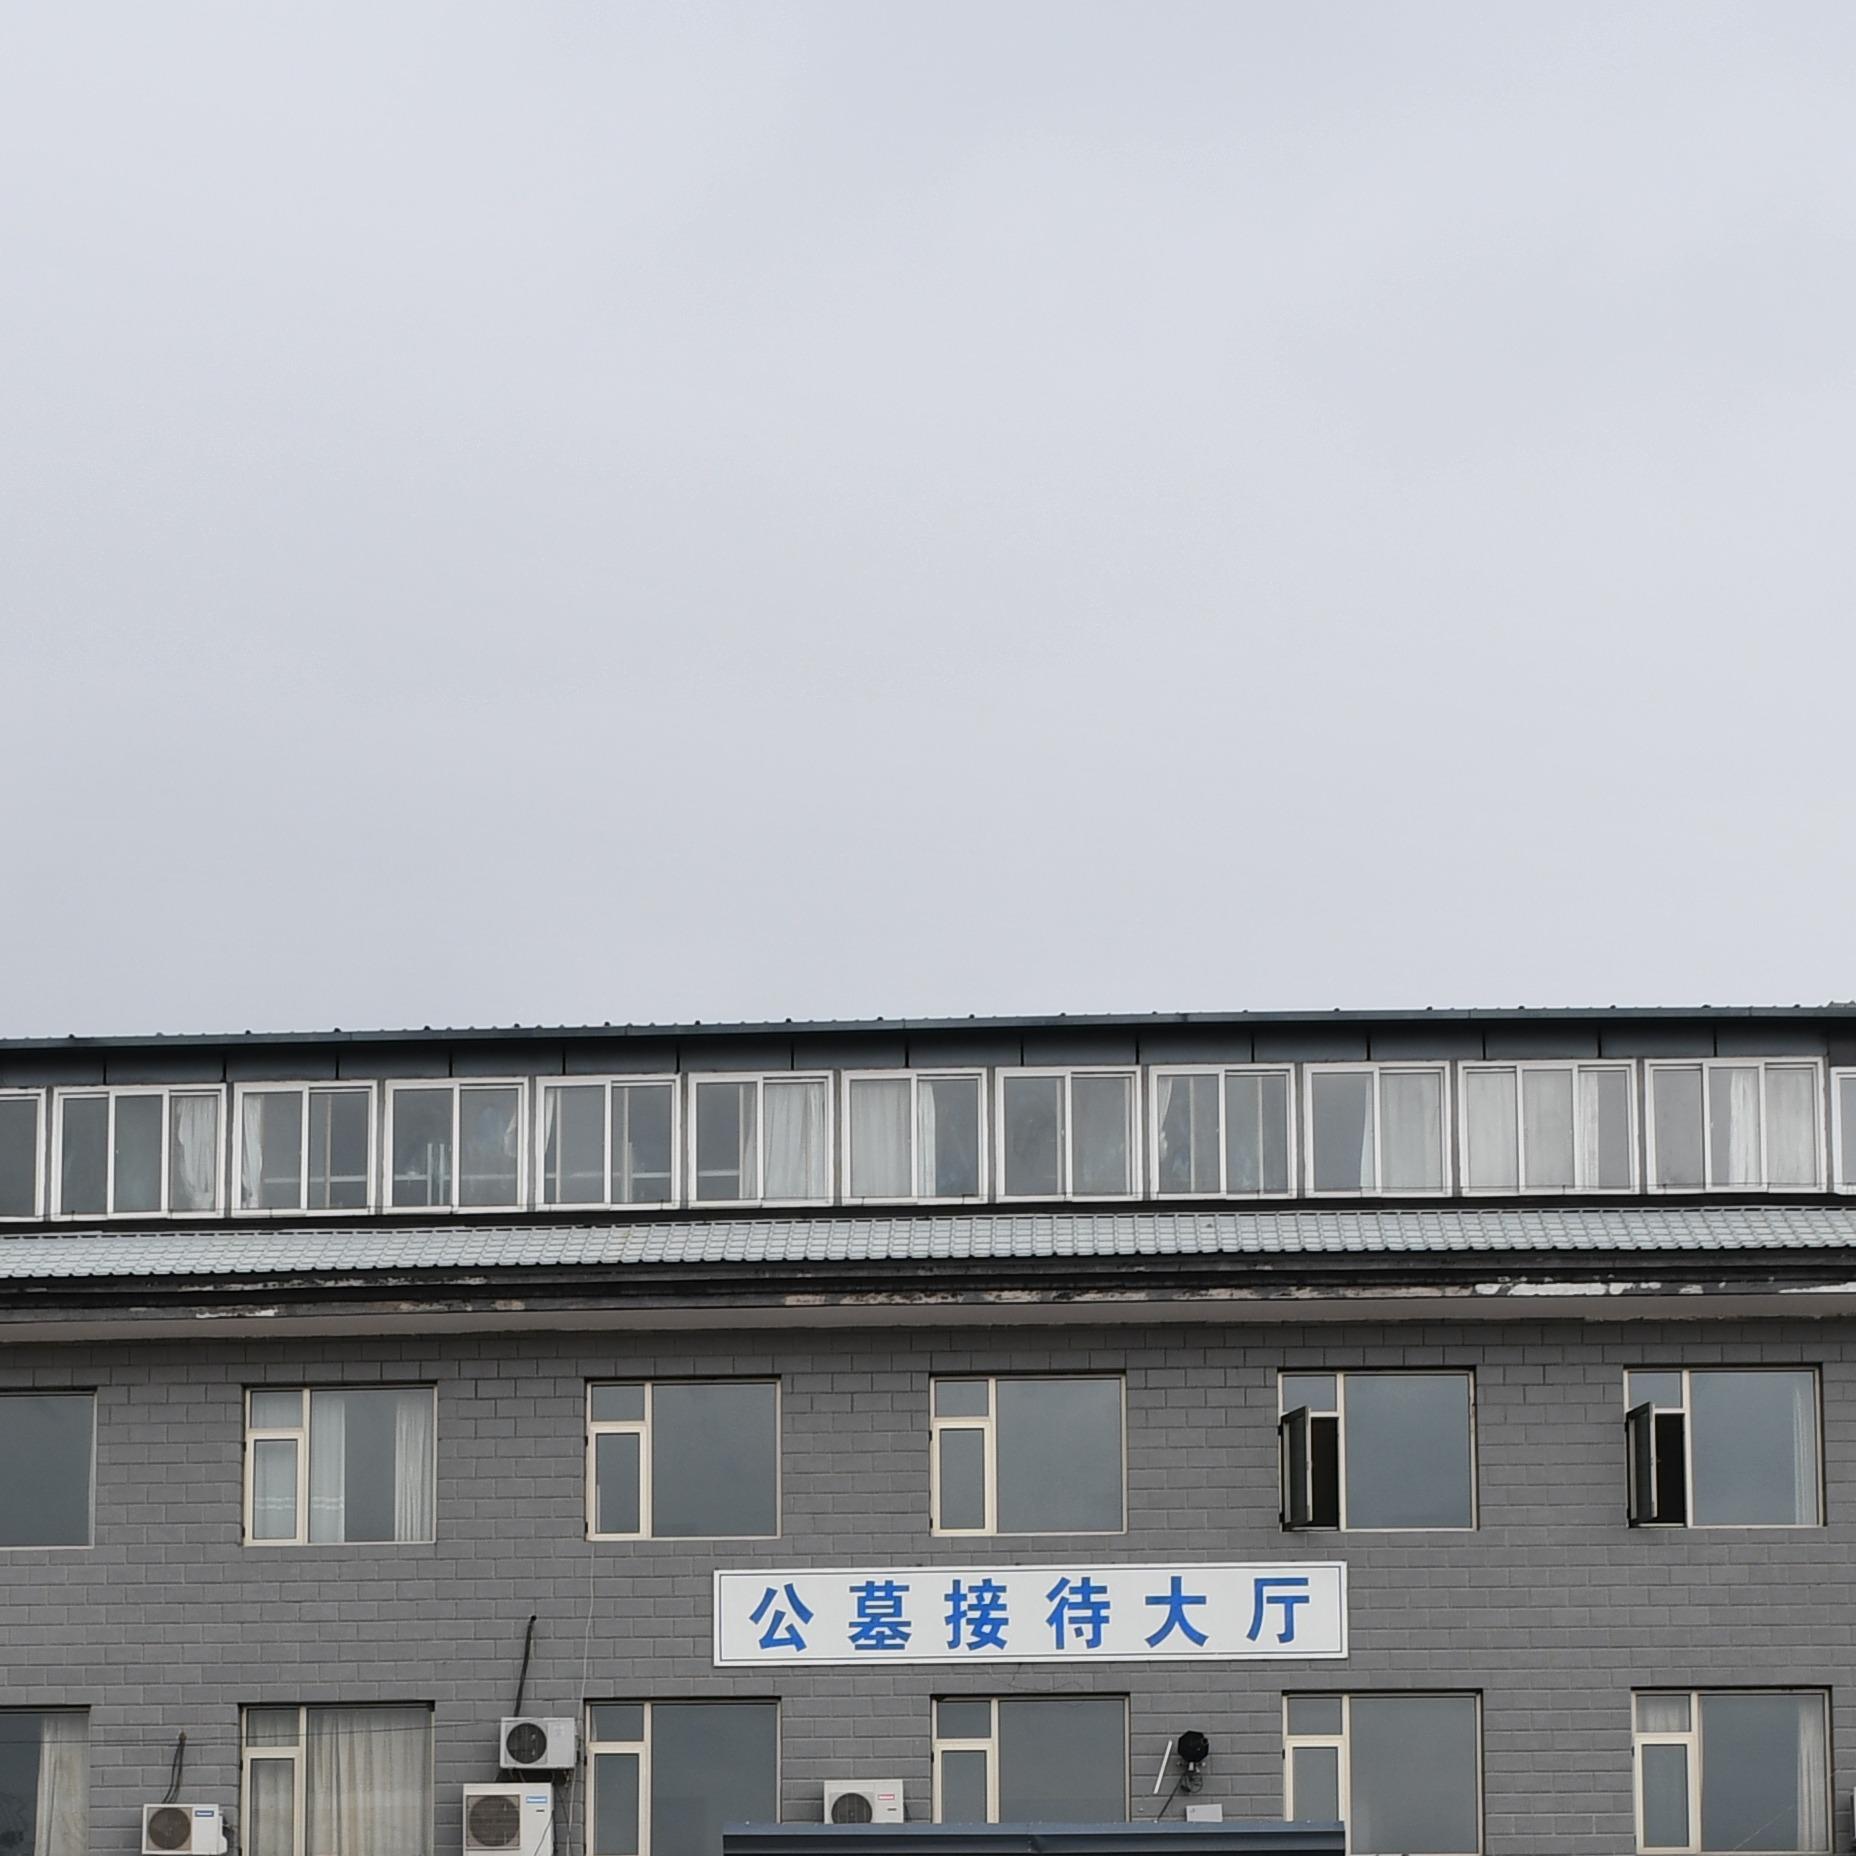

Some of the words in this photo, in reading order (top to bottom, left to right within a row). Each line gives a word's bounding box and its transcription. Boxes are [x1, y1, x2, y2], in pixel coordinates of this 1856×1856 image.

[749, 1576, 1311, 1652] 公墓接待大厅
